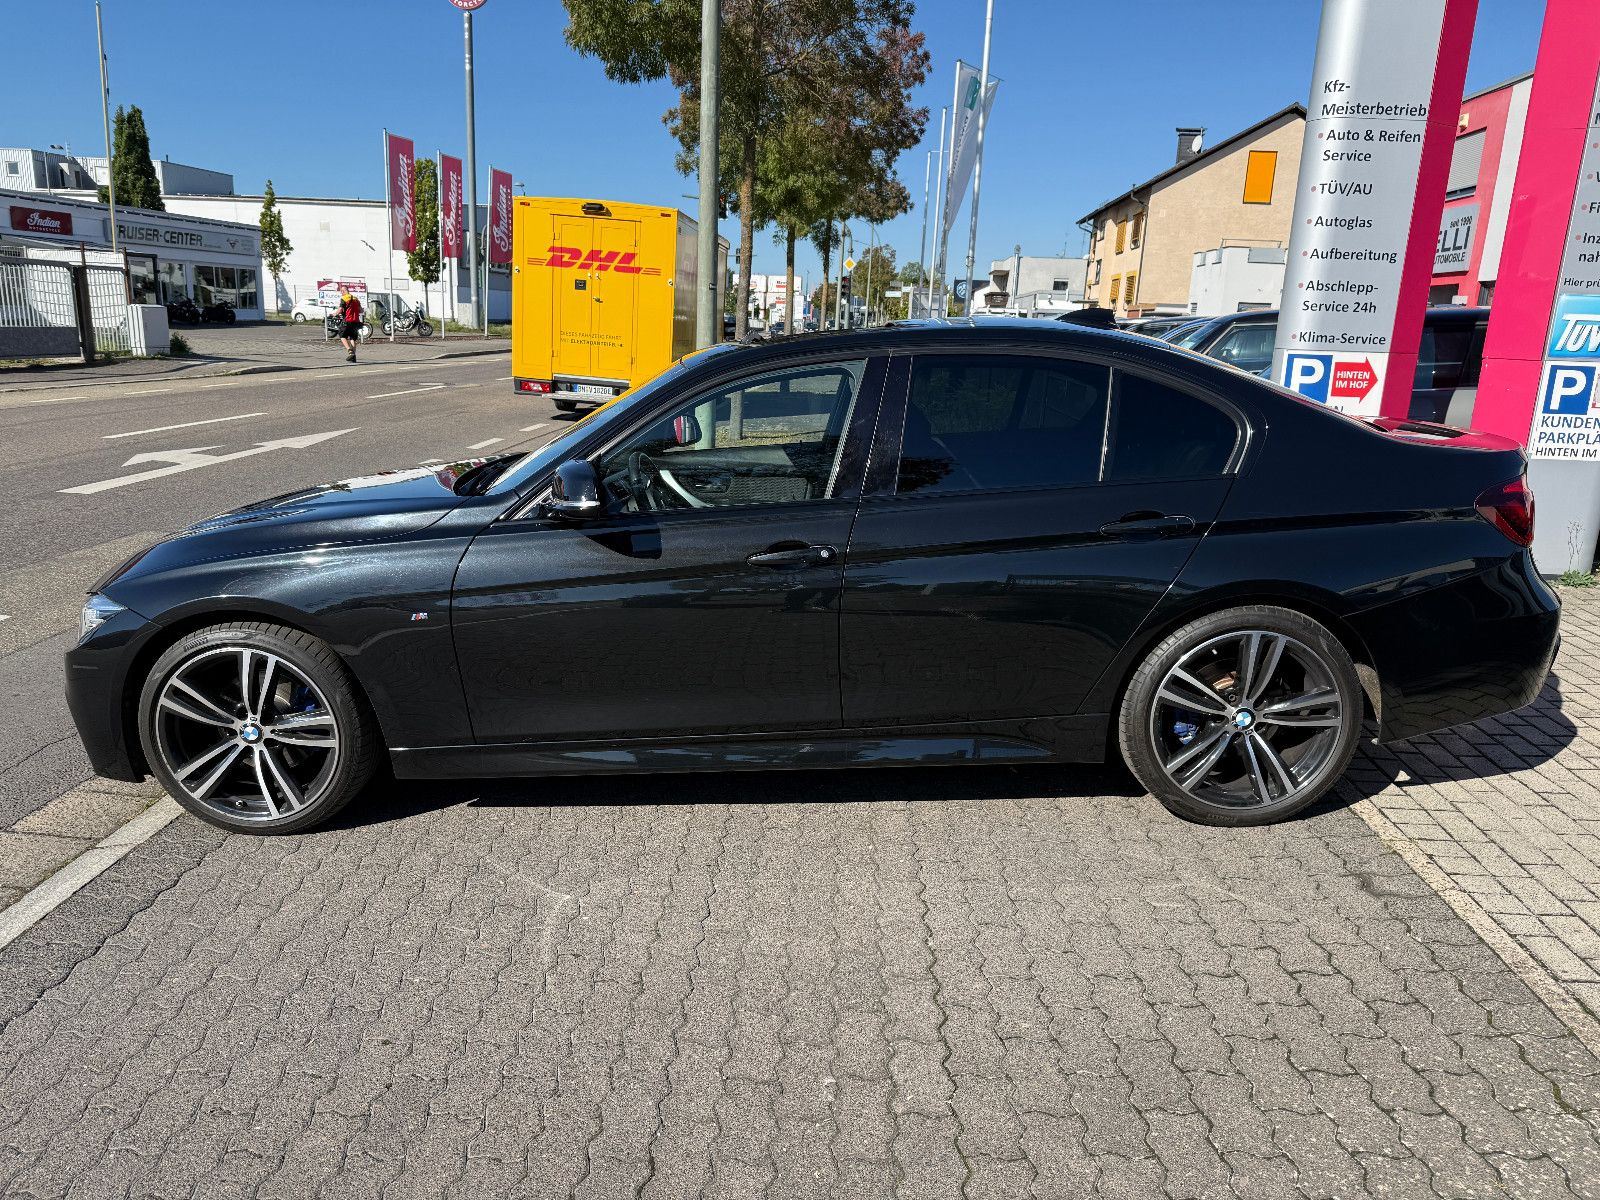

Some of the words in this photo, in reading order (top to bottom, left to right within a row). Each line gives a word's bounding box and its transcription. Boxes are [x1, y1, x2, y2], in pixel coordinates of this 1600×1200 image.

[1324, 80, 1351, 93] Kfz-
[1321, 101, 1427, 117] Meisterbetrieb
[1326, 129, 1360, 141] Auto
[1364, 129, 1374, 141] &
[1378, 130, 1421, 143] Reifen
[1322, 149, 1372, 162] Service
[1319, 180, 1373, 197] TÜV/AU
[445, 171, 457, 245] Indian
[27, 212, 60, 228] Indian
[493, 184, 508, 252] Indian
[1314, 215, 1373, 230] Autoglas
[113, 223, 203, 246] RUISER-CENTER
[545, 245, 644, 275] DHL
[1310, 248, 1397, 264] Aufbereitung
[1305, 280, 1379, 294] Abschlepp-
[1563, 277, 1584, 287] Hier
[1302, 300, 1349, 313] Service
[1353, 302, 1377, 313] 24h
[1299, 331, 1386, 345] Klima-Service
[1290, 357, 1325, 393] P
[1336, 370, 1370, 380] HINTEN
[1335, 380, 1348, 389] IM
[1349, 380, 1369, 389] HOF
[1550, 369, 1587, 410] P
[1535, 447, 1579, 457] HINTEN
[1582, 449, 1597, 458] IM
